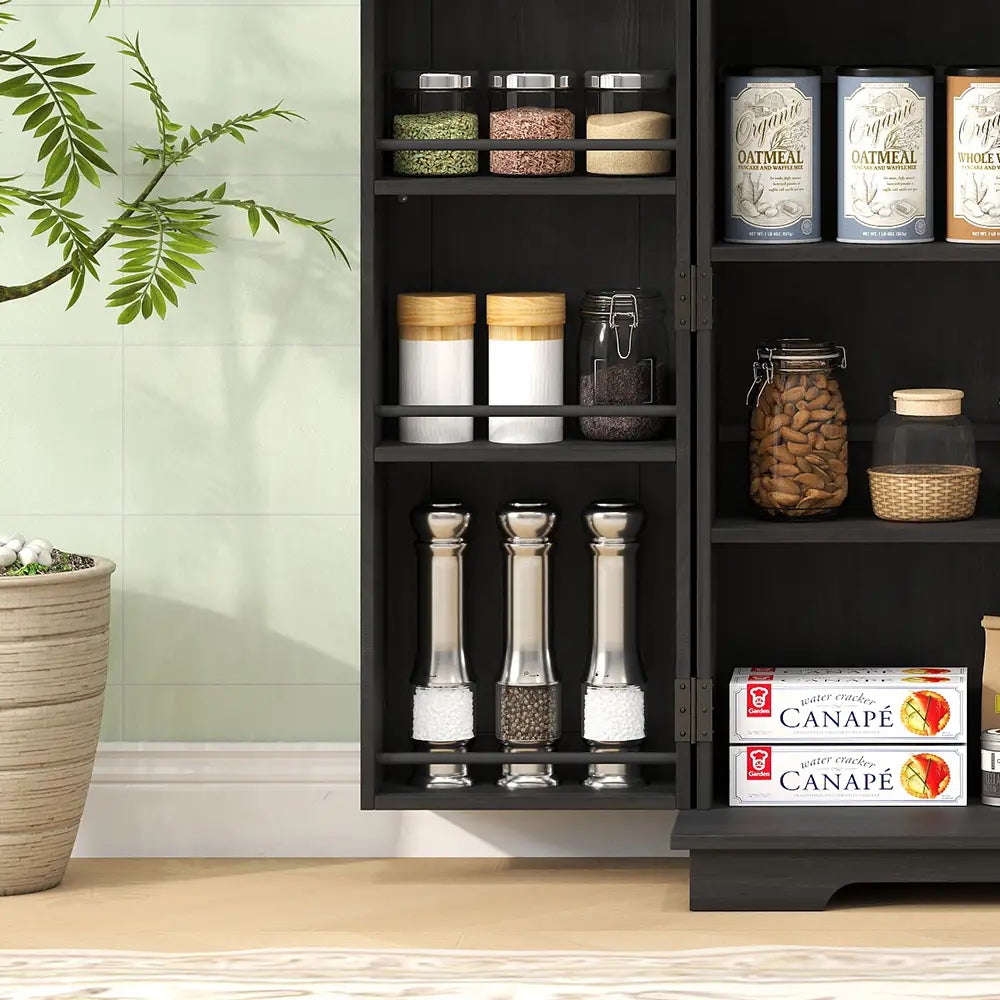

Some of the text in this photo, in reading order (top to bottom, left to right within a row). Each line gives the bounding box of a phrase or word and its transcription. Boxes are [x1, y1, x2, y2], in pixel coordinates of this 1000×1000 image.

[736, 100, 802, 149] Organic
[849, 100, 916, 148] Organic
[738, 149, 804, 164] OATMEAL
[851, 149, 918, 164] OATMEAL
[957, 152, 994, 164] WHOLE
[801, 693, 876, 706] water cracker
[780, 705, 894, 728] CANAPÉ
[801, 756, 876, 769] water cracker
[780, 768, 894, 791] CANAPÉ
